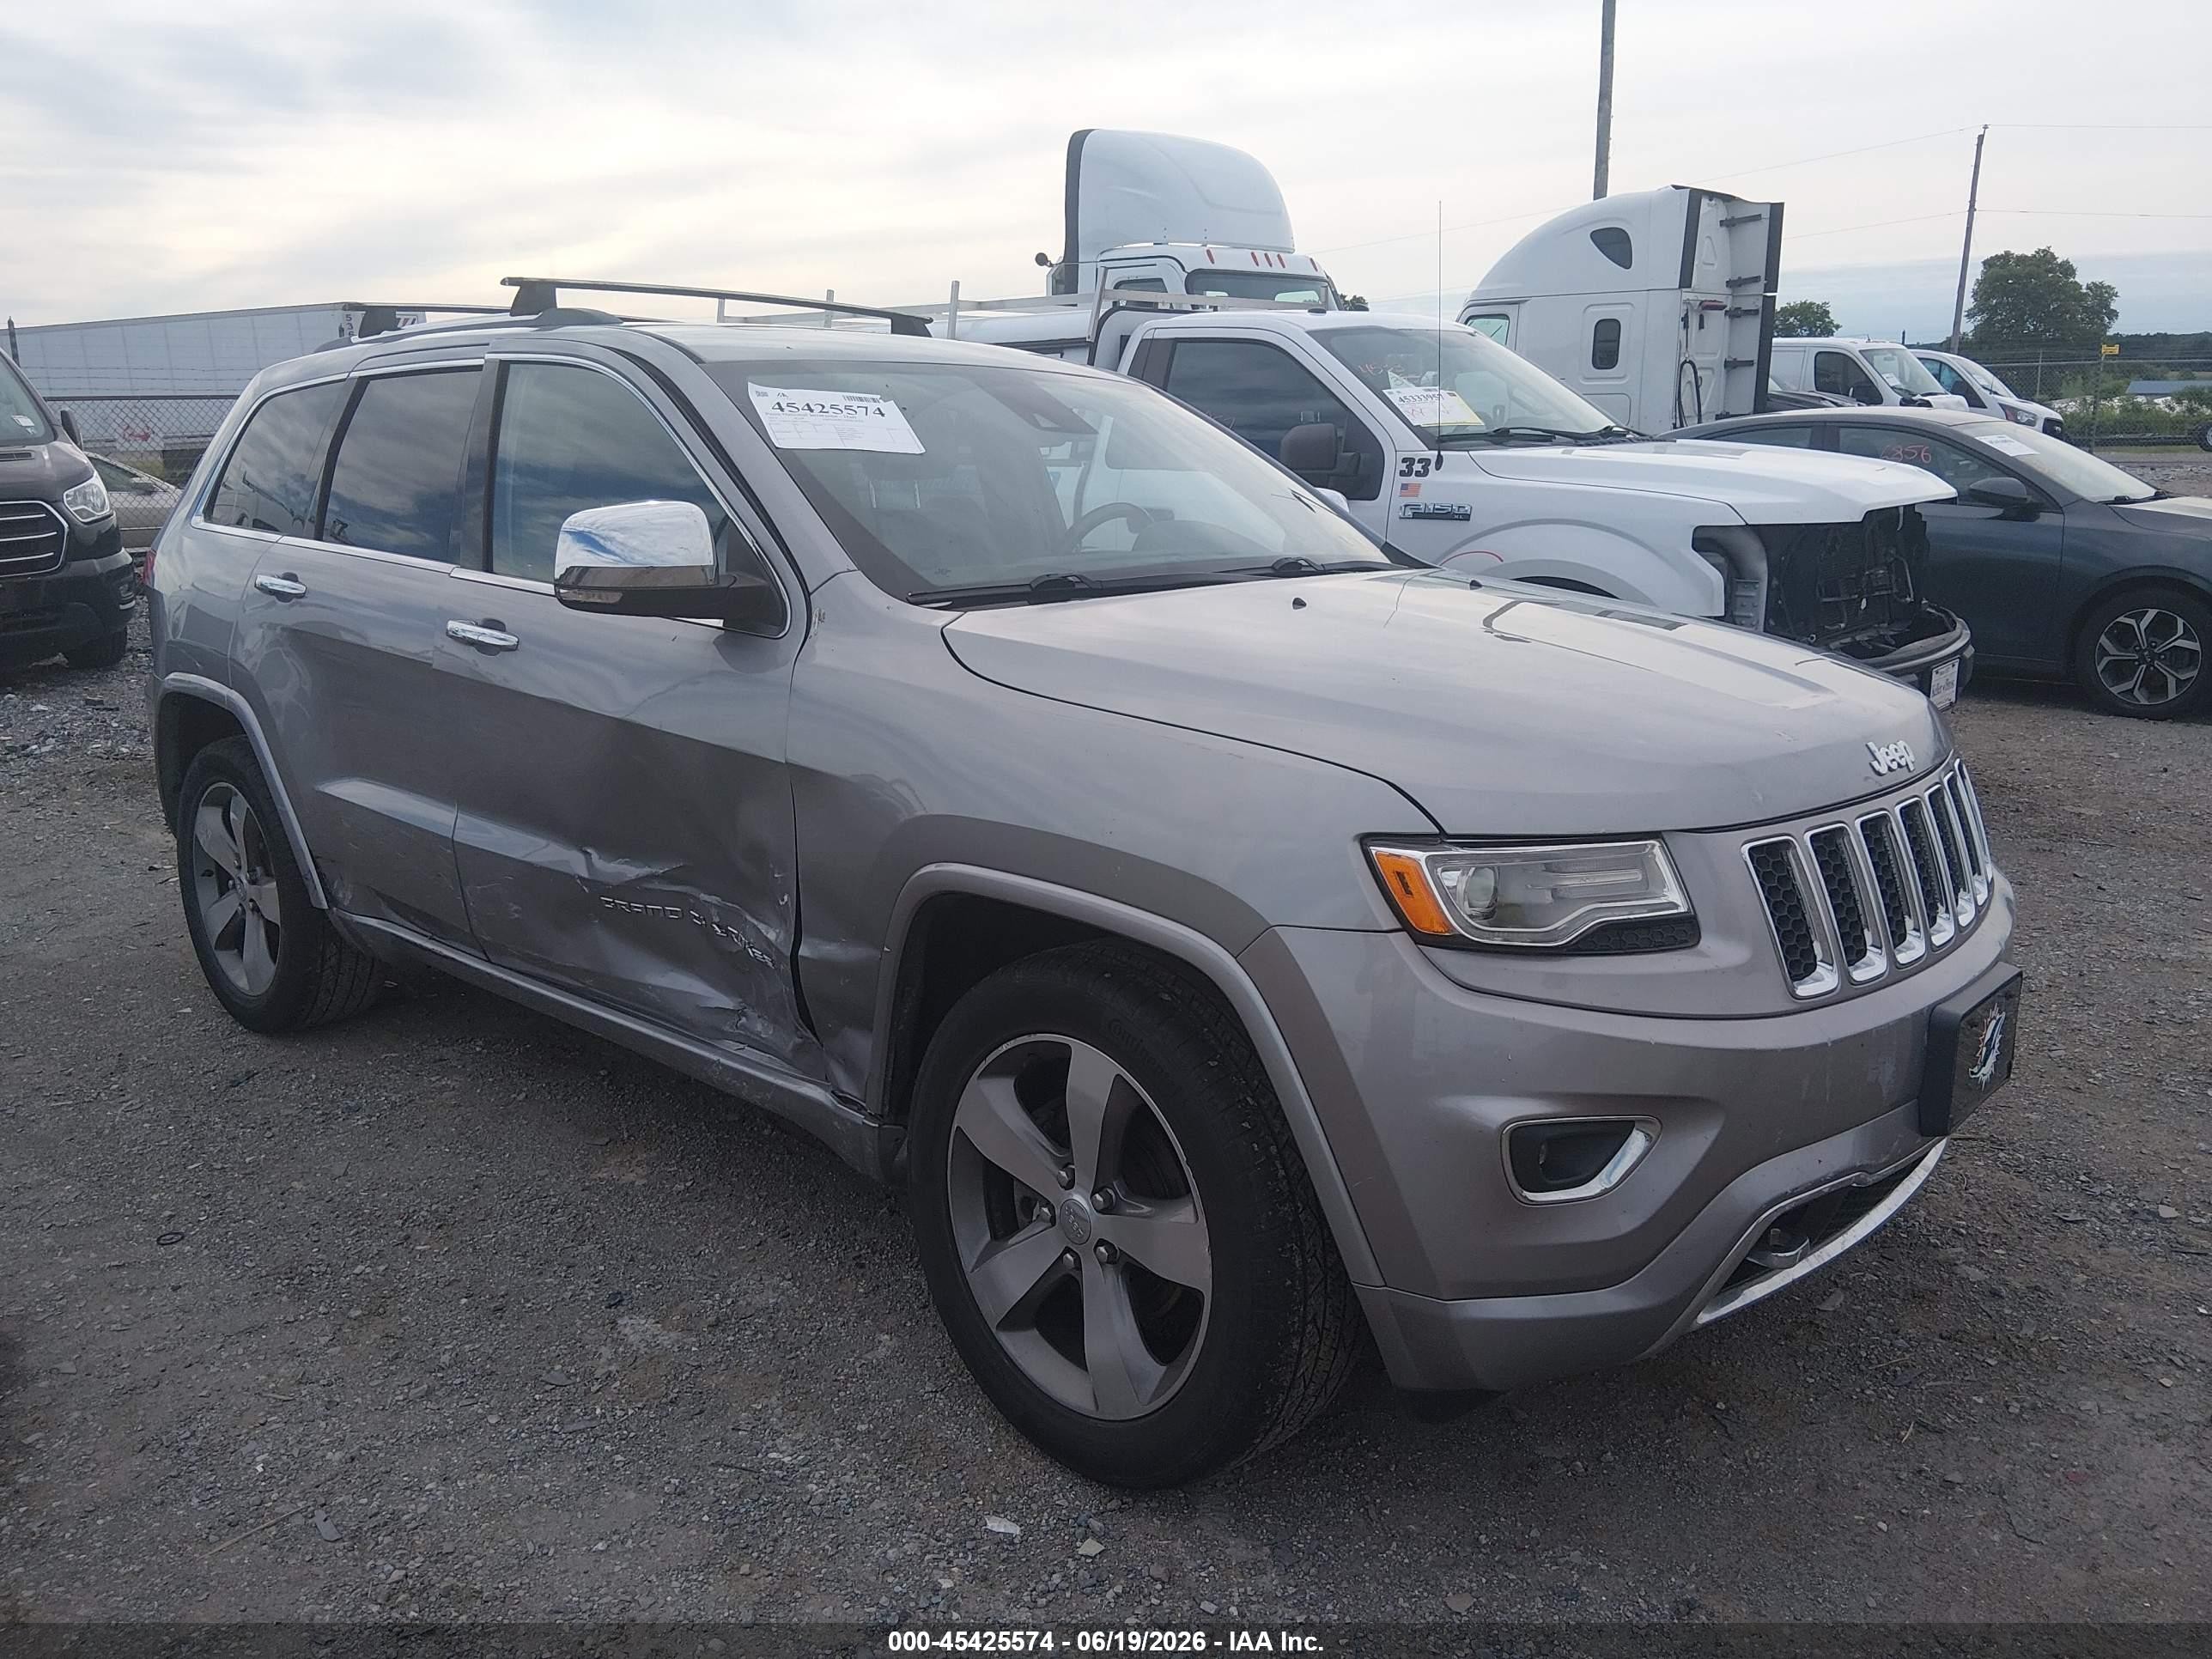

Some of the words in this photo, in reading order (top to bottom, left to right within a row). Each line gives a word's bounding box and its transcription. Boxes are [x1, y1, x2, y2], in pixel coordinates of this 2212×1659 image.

[771, 401, 886, 417] 45425574
[1399, 457, 1431, 477] 33
[1865, 740, 1916, 776] Jeep
